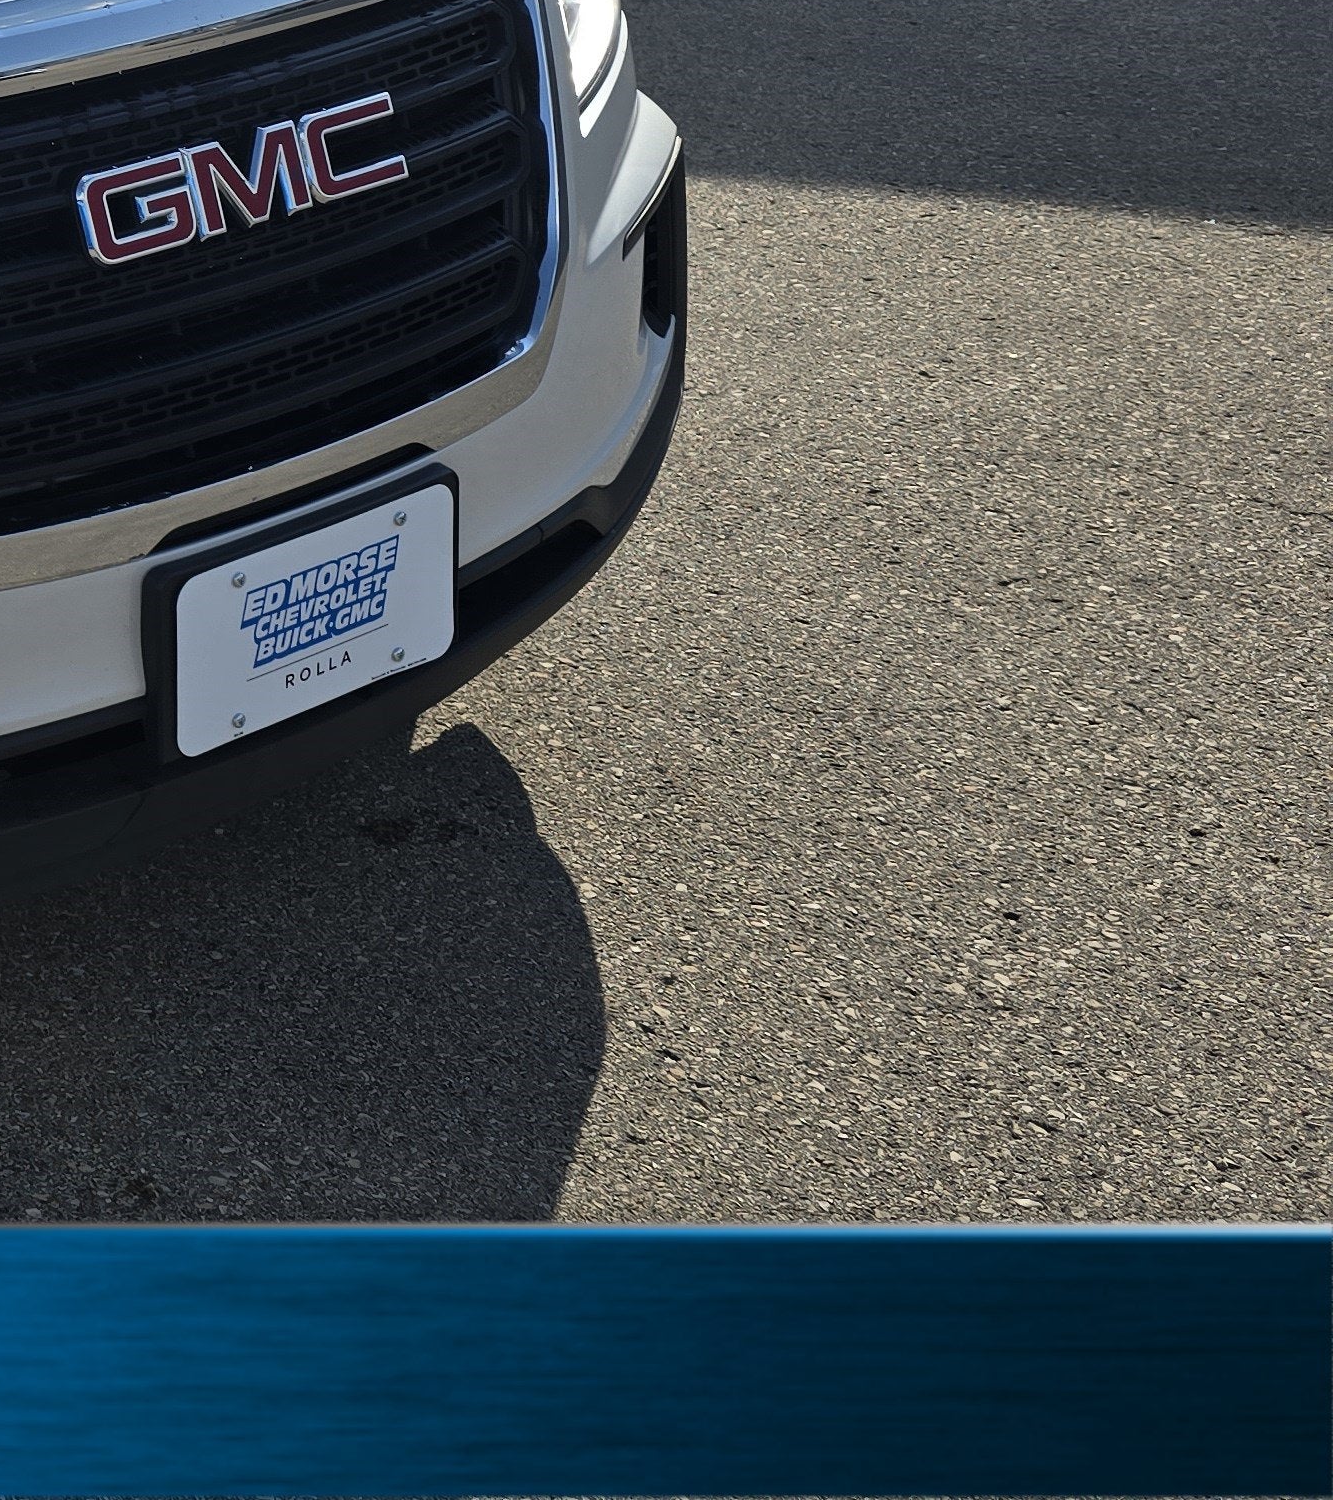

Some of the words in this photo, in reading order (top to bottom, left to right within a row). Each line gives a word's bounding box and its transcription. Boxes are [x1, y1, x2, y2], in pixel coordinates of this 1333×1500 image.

[76, 91, 410, 266] GMC
[242, 583, 288, 623] ED
[289, 537, 397, 605] MORSE
[285, 650, 352, 689] ROLLA
